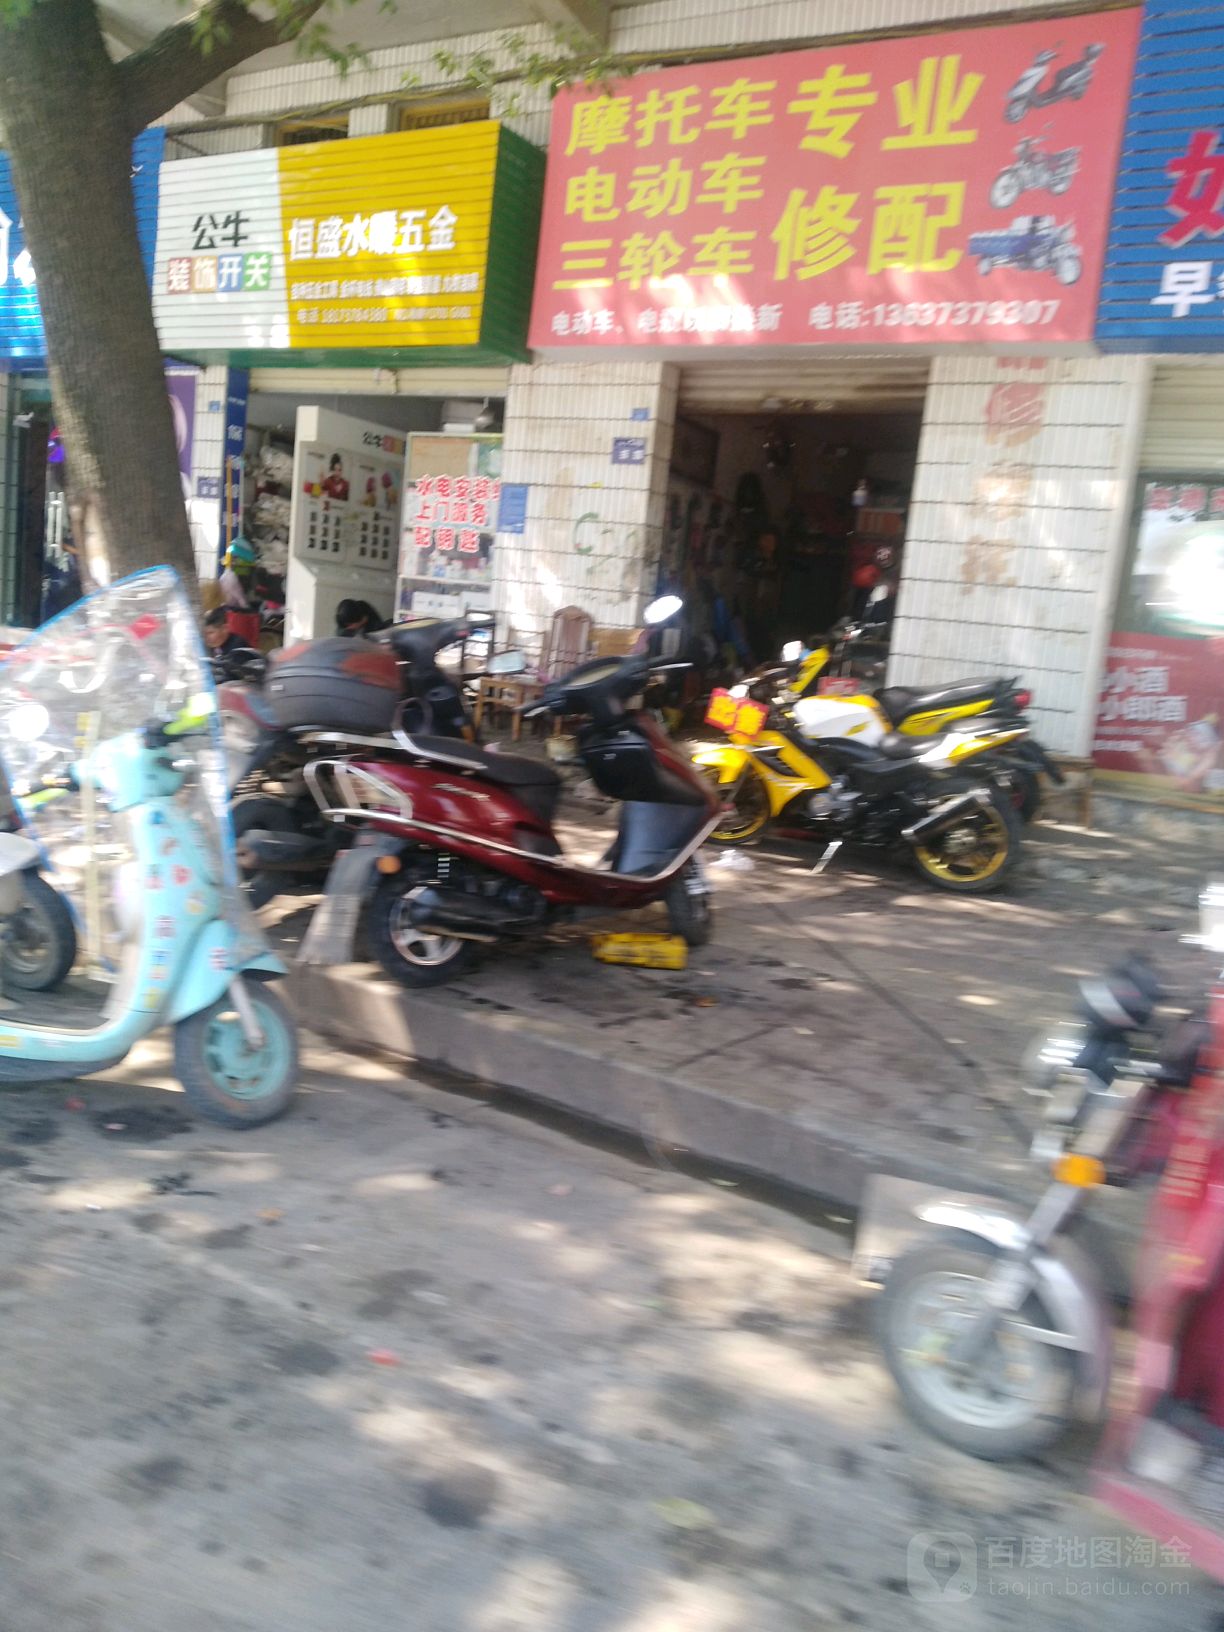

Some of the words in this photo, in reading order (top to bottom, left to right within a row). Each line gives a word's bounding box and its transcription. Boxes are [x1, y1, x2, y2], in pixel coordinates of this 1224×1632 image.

[564, 78, 777, 157] 摩托车
[787, 54, 986, 158] 专业
[565, 152, 766, 223] 电动车
[192, 210, 250, 250] 公牛
[552, 227, 758, 291] 三轮车
[771, 181, 967, 282] 修配
[167, 253, 270, 292] 装饰开关
